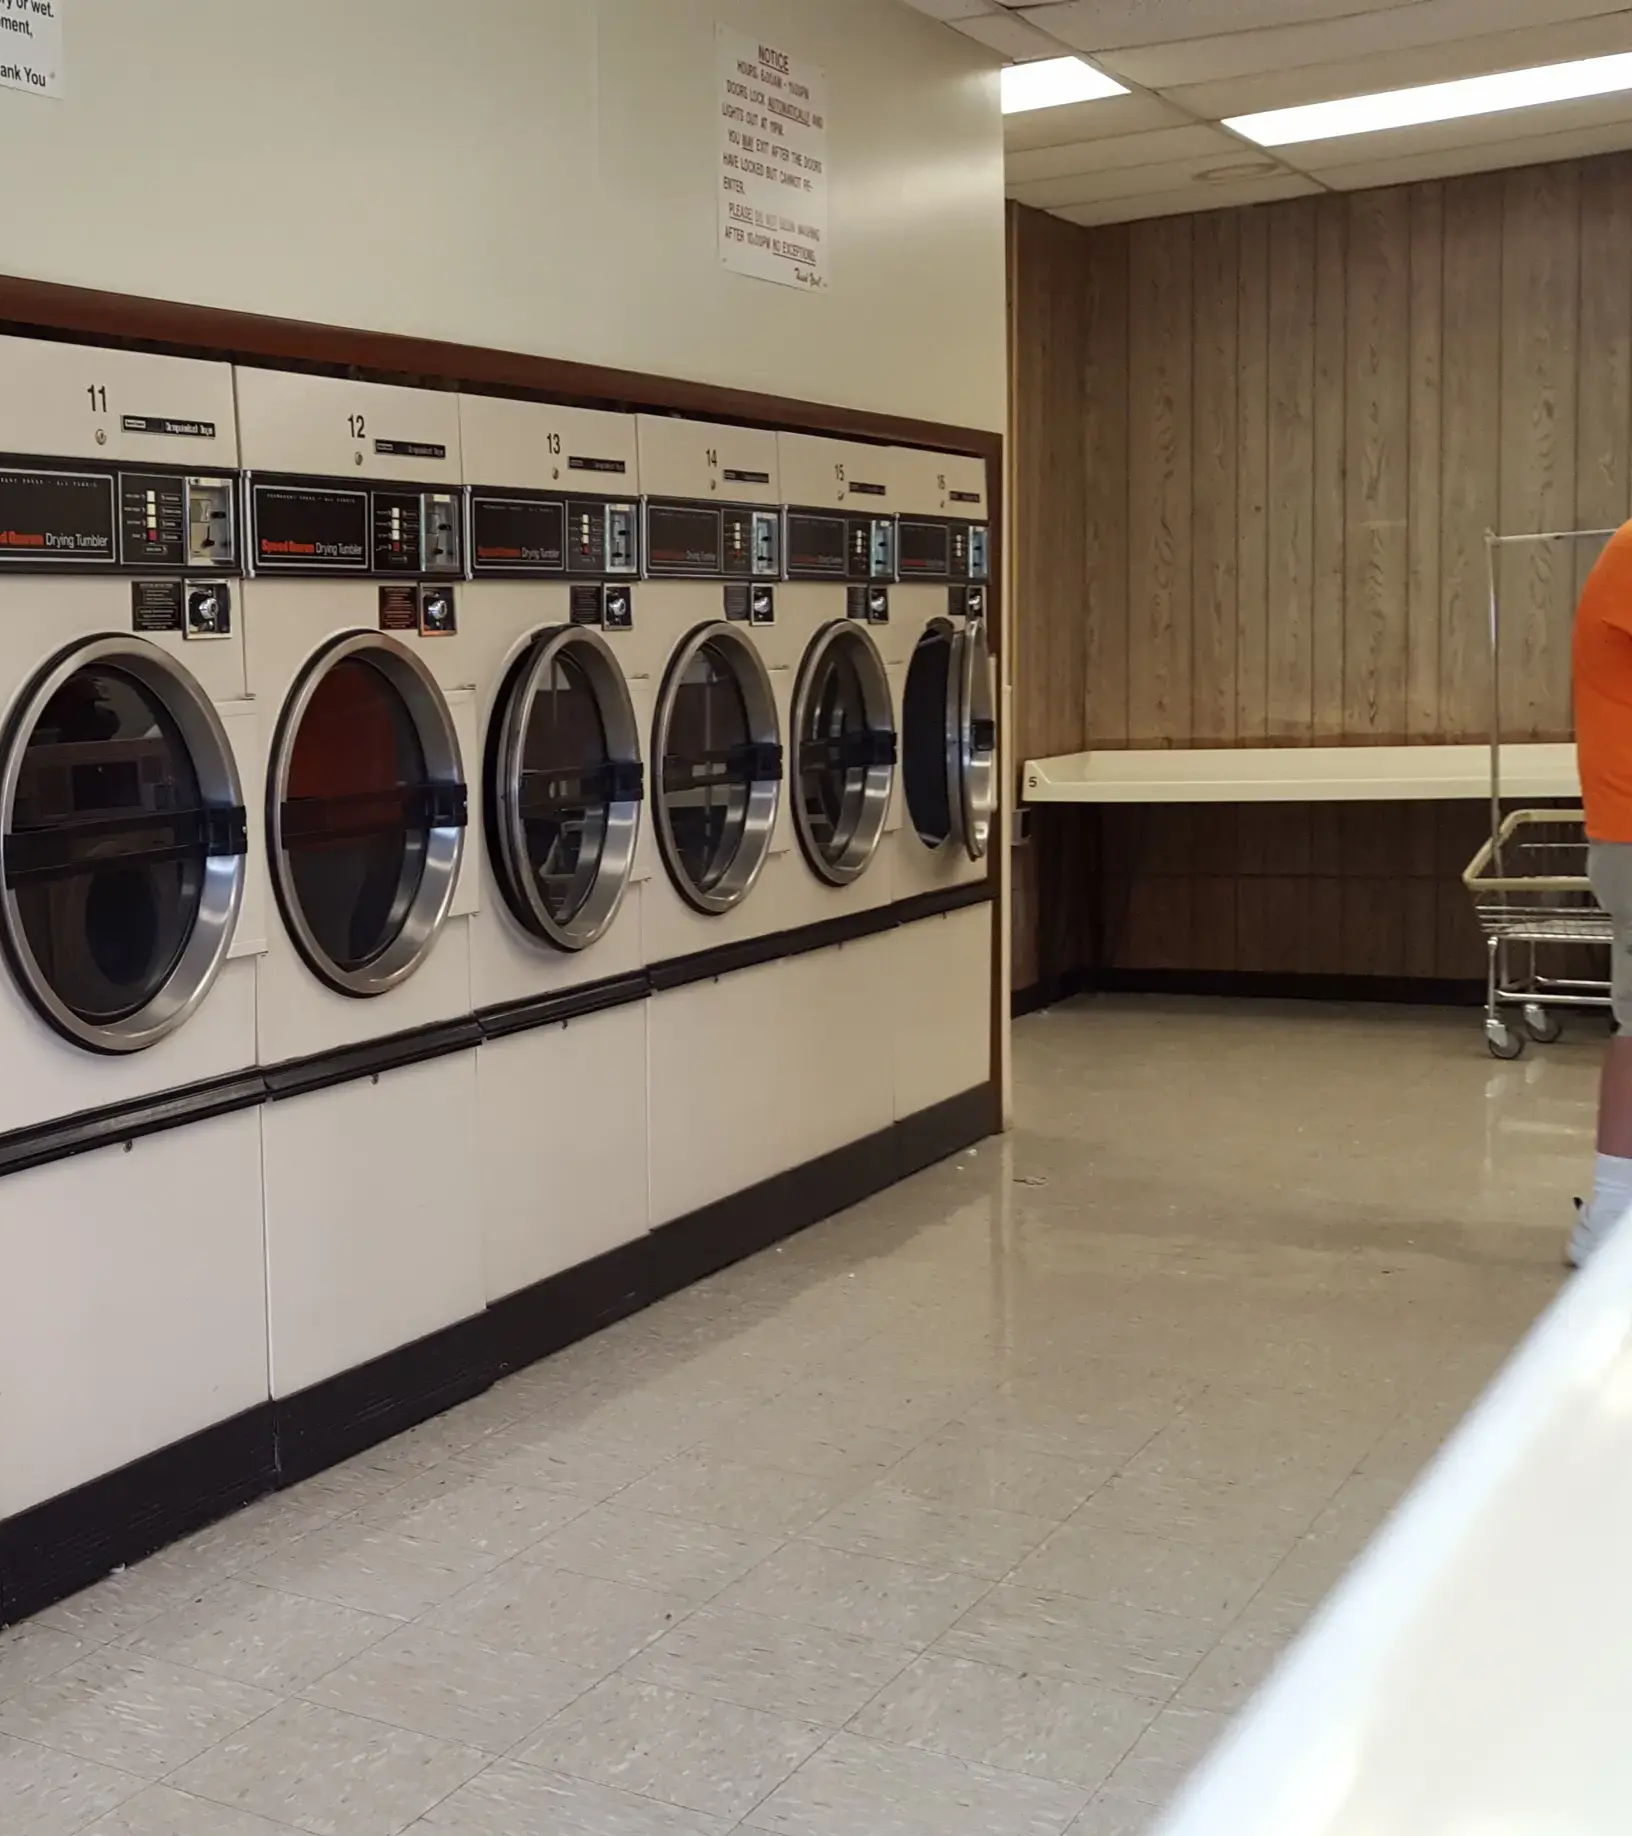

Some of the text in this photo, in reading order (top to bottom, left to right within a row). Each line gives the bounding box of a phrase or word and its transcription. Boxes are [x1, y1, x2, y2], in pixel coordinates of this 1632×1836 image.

[31, 0, 55, 18] wet.
[758, 44, 790, 72] NOTICE
[24, 67, 47, 88] You
[729, 202, 753, 221] PLEASE
[87, 384, 107, 413] 11
[347, 414, 366, 439] 12
[546, 433, 561, 454] 13
[706, 449, 717, 468] 14
[834, 463, 845, 481] 15
[45, 532, 74, 548] Drying
[75, 533, 108, 547] Tumbler
[315, 542, 338, 556] Drying
[1028, 776, 1038, 788] 5
